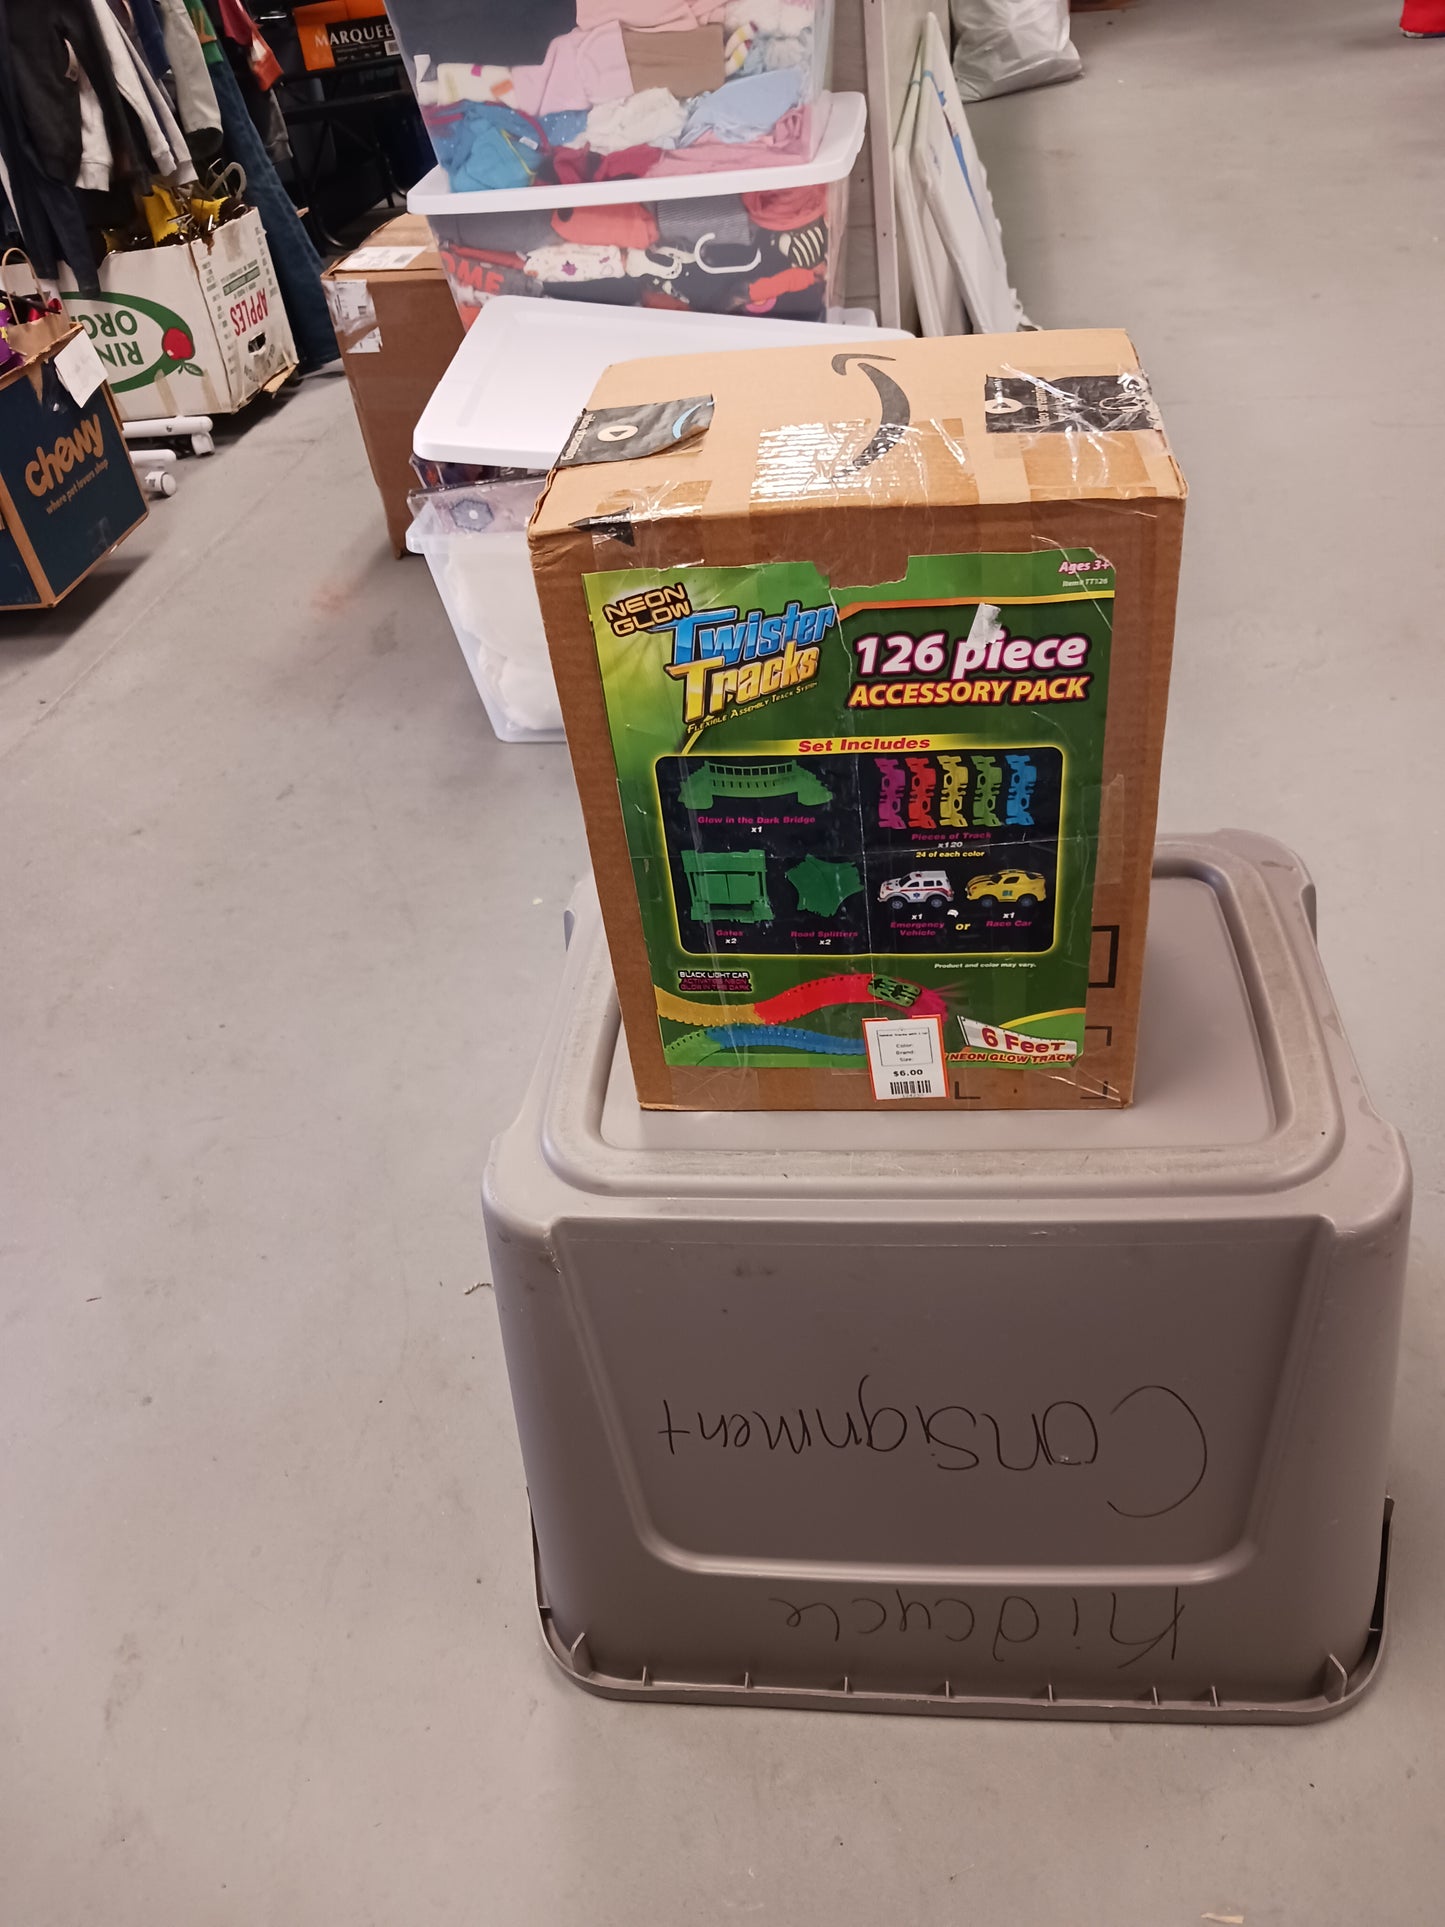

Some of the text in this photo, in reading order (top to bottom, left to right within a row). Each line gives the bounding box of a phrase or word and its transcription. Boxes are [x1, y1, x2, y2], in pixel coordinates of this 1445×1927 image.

[314, 24, 395, 47] MARQUEE
[230, 287, 268, 336] APPLES
[71, 310, 137, 339] ORC
[25, 413, 104, 497] chewy
[46, 494, 67, 514] where
[66, 484, 78, 501] pet
[94, 459, 108, 475] shop
[1059, 560, 1110, 574] Ages 3+
[604, 585, 685, 620] NEON
[613, 601, 690, 635] GLOW
[653, 603, 836, 666] Twister
[856, 629, 1087, 680] 126 piece
[667, 641, 819, 723] Tracks
[849, 676, 1090, 707] ACCESSORY PACK
[798, 738, 930, 753] Set Includes
[698, 816, 815, 825] Glow in the Dark Bridge
[912, 833, 948, 841] Pieces
[962, 832, 991, 840] Track
[962, 850, 985, 858] color
[716, 929, 744, 937] Gates
[817, 930, 859, 938] Splitters
[890, 921, 945, 930] Emergency
[955, 923, 971, 931] or
[981, 1027, 998, 1048] 6
[950, 1053, 987, 1061] NEON
[988, 1053, 1029, 1062] GLOW
[1029, 1053, 1075, 1063] TRACK
[893, 1069, 923, 1077] $6.00
[659, 1375, 1207, 1518] Consignment
